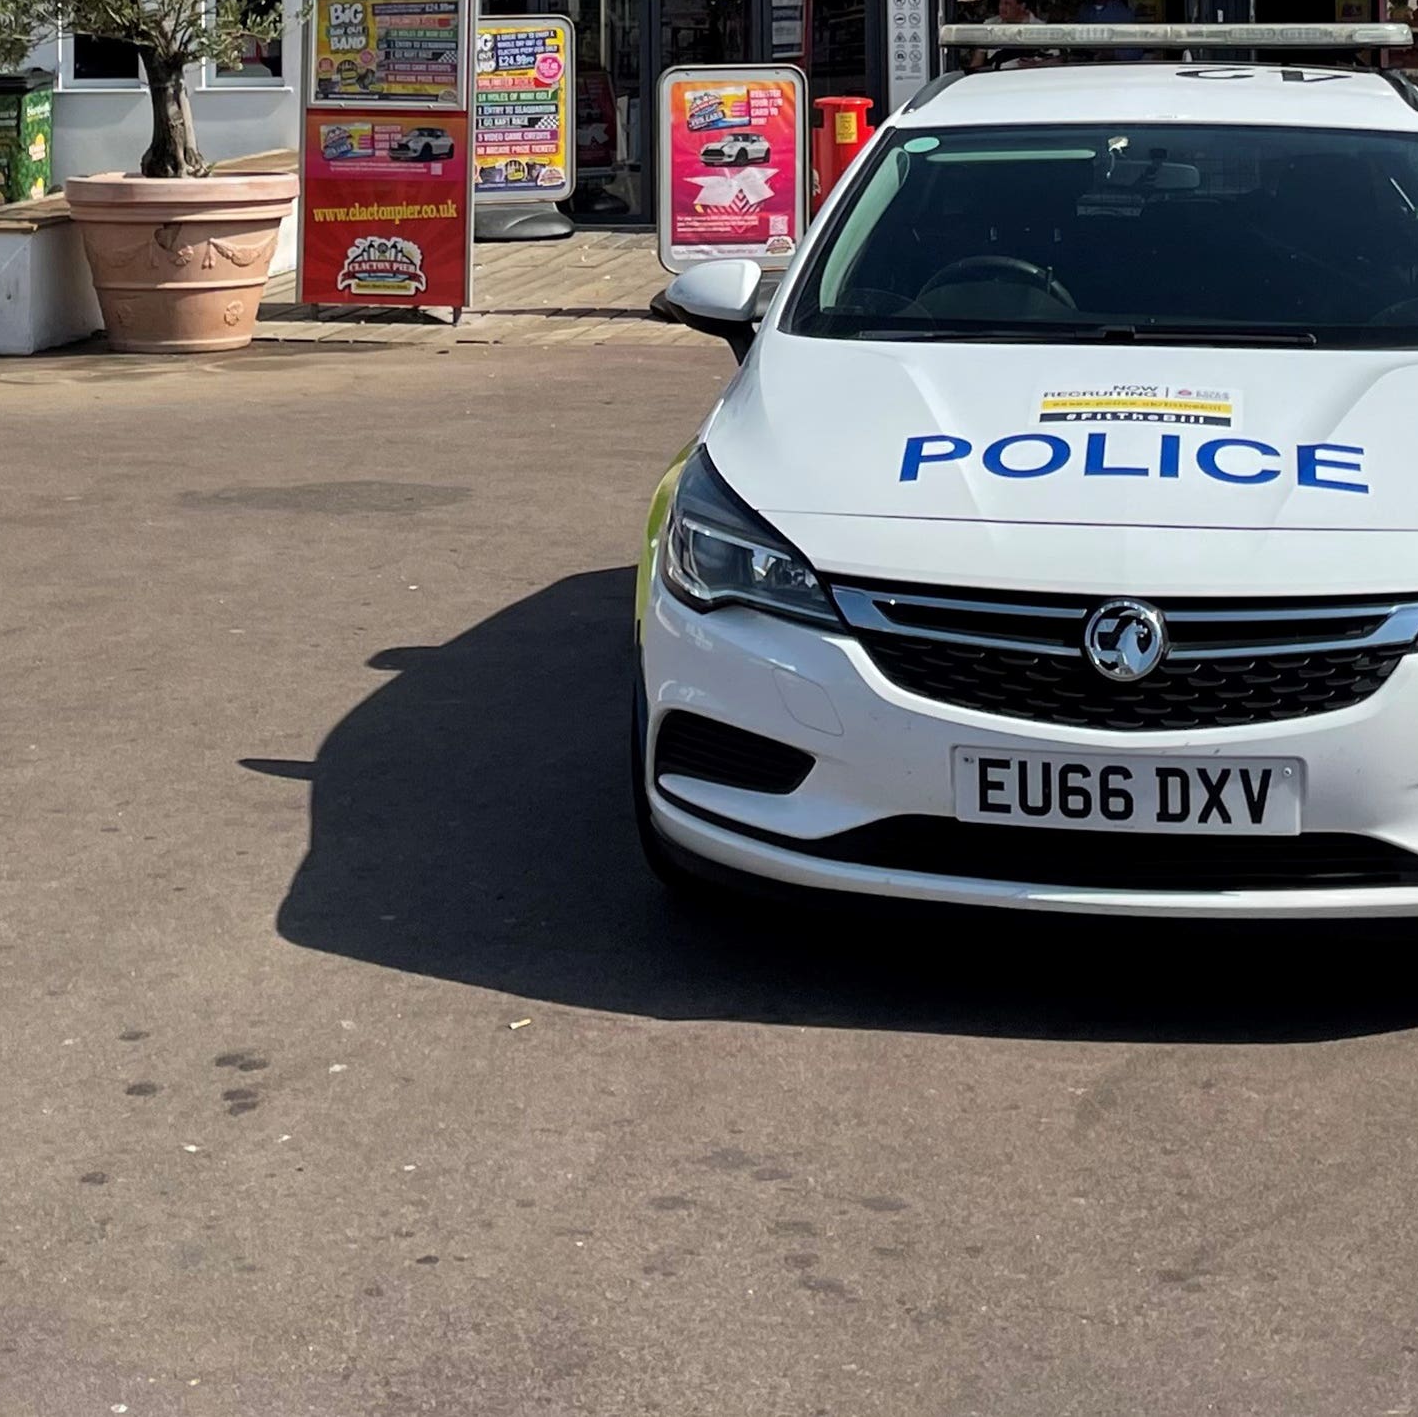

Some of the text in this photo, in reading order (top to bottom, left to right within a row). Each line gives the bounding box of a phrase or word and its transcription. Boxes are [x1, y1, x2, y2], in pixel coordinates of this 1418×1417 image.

[330, 35, 366, 50] BAND
[313, 200, 458, 225] www.clactonpier.co.uk
[348, 261, 416, 272] CLACTON PIER
[1043, 390, 1158, 398] RECRUITING
[1066, 412, 1205, 424] #FitTheBill
[899, 433, 1369, 494] POLICE
[977, 757, 1273, 826] EU66 DXV
